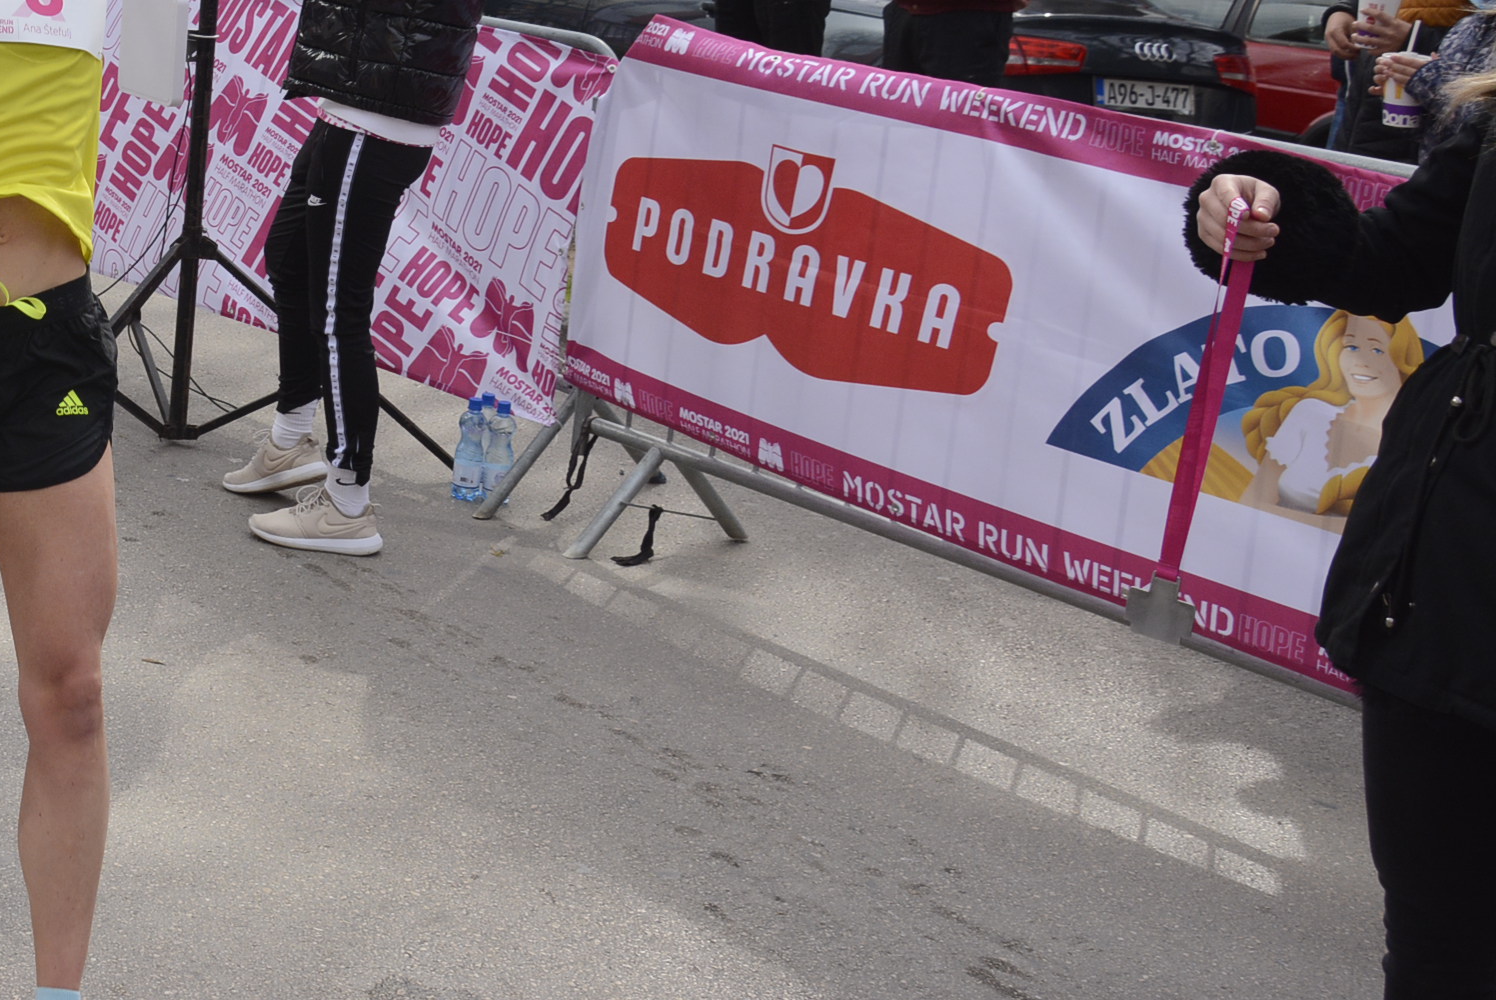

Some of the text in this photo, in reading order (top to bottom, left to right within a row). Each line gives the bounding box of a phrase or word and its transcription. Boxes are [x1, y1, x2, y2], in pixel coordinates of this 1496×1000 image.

[23, 24, 41, 34] Ana
[647, 21, 669, 37] 2021
[482, 93, 523, 125] MOSTAR 2021
[692, 36, 1147, 157] HOPE MOSTAR RUN WEEKEND HOPE
[1108, 80, 1191, 109] A96-J-477
[265, 127, 288, 146] MOSTAR
[465, 109, 513, 160] HOPE
[505, 88, 594, 216] HO
[1152, 130, 1223, 158] MOSTAR
[248, 142, 291, 190] HOPE
[1151, 148, 1181, 165] HALF
[215, 165, 267, 209] HALF MARATHON
[219, 154, 272, 199] MOSTAR 2021
[105, 186, 122, 206] MOSTAR
[432, 139, 574, 303] HOPE
[428, 233, 481, 285] HALF MARATHON
[431, 221, 483, 274] MOSTAR 2021
[398, 245, 481, 325] HOPE
[631, 194, 964, 350] PODRAVKA
[241, 289, 279, 324] MARATHO
[489, 377, 511, 398] HALF
[496, 366, 543, 405] MOSTAR
[591, 367, 611, 387] 2021
[1089, 328, 1302, 454] ZLATO
[56, 404, 89, 416] adidas
[638, 389, 675, 424] HOPE
[679, 407, 750, 445] MOSTAR 2021
[680, 420, 700, 436] HALF
[791, 450, 1307, 664] HOPE MOSTAR RUN WEEND HOPE
